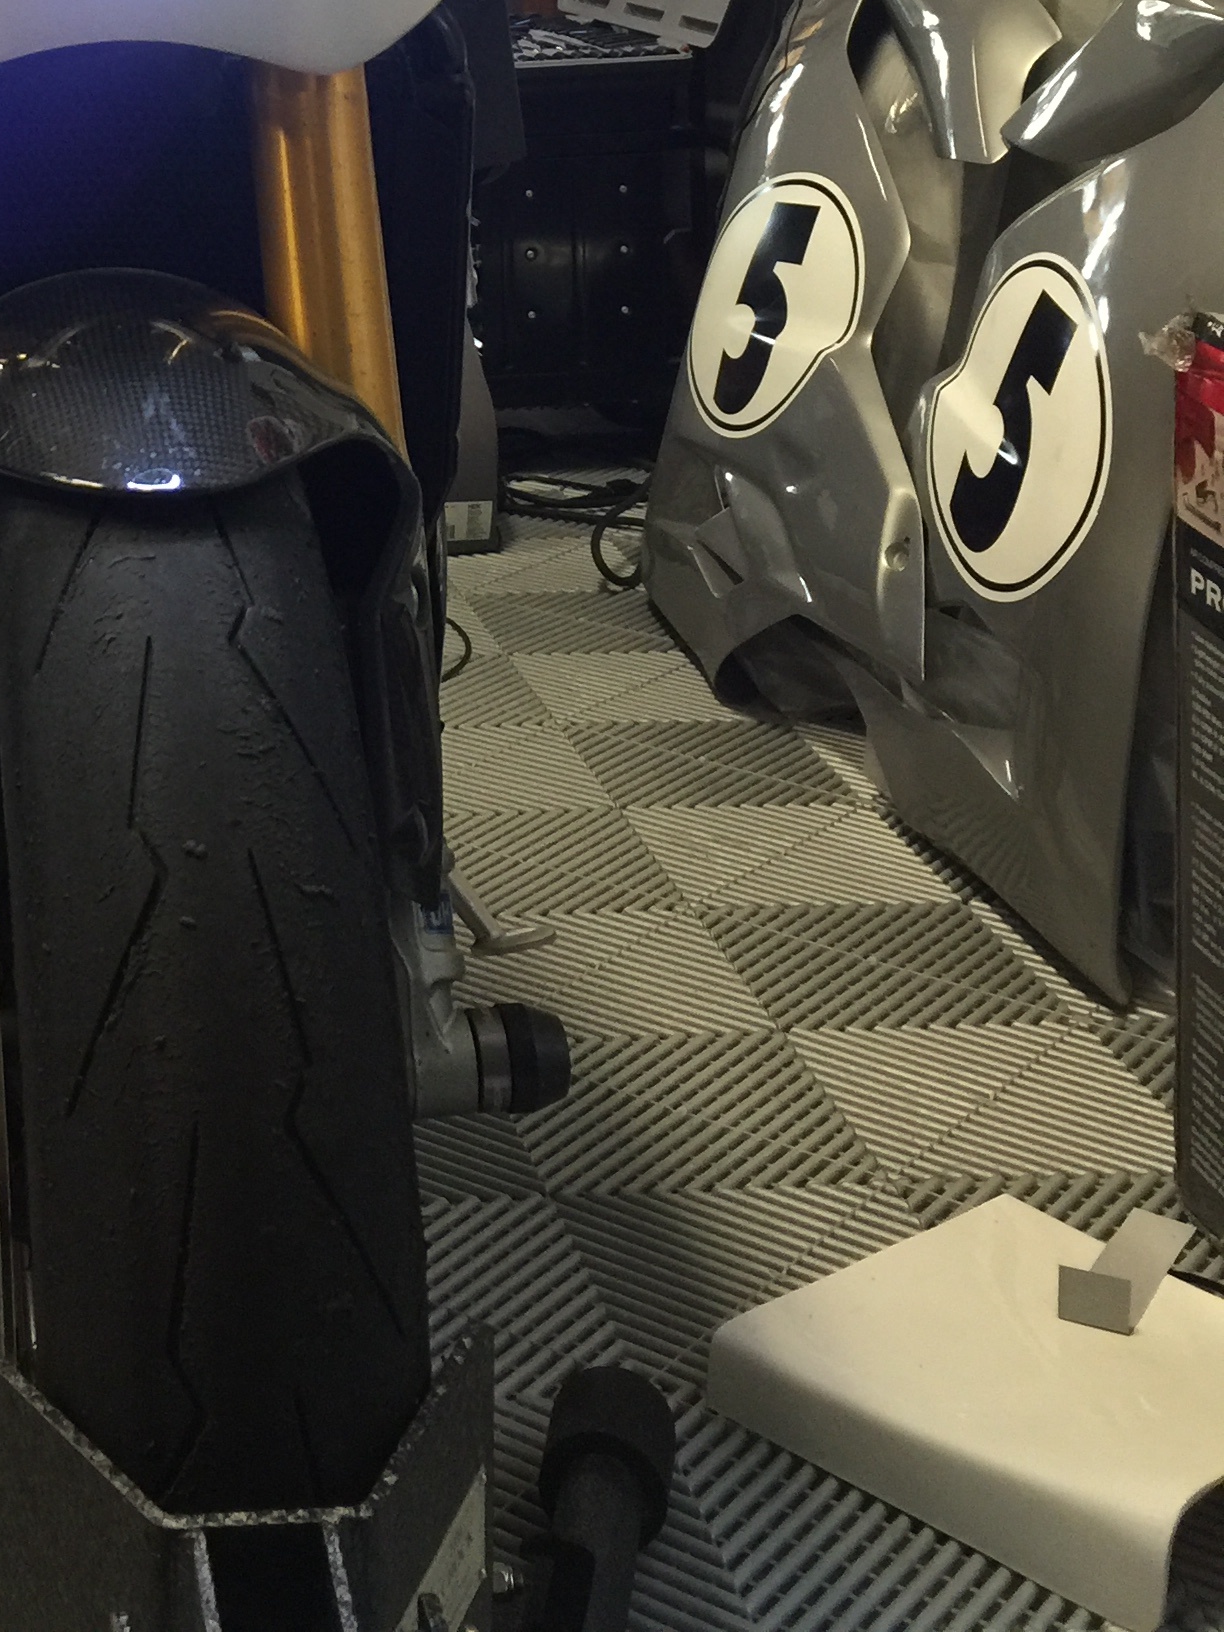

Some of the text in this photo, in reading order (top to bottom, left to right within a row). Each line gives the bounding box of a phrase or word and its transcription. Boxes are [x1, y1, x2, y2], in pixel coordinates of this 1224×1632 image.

[713, 201, 821, 415] 5
[950, 289, 1079, 553] 5
[1190, 567, 1224, 613] PR
